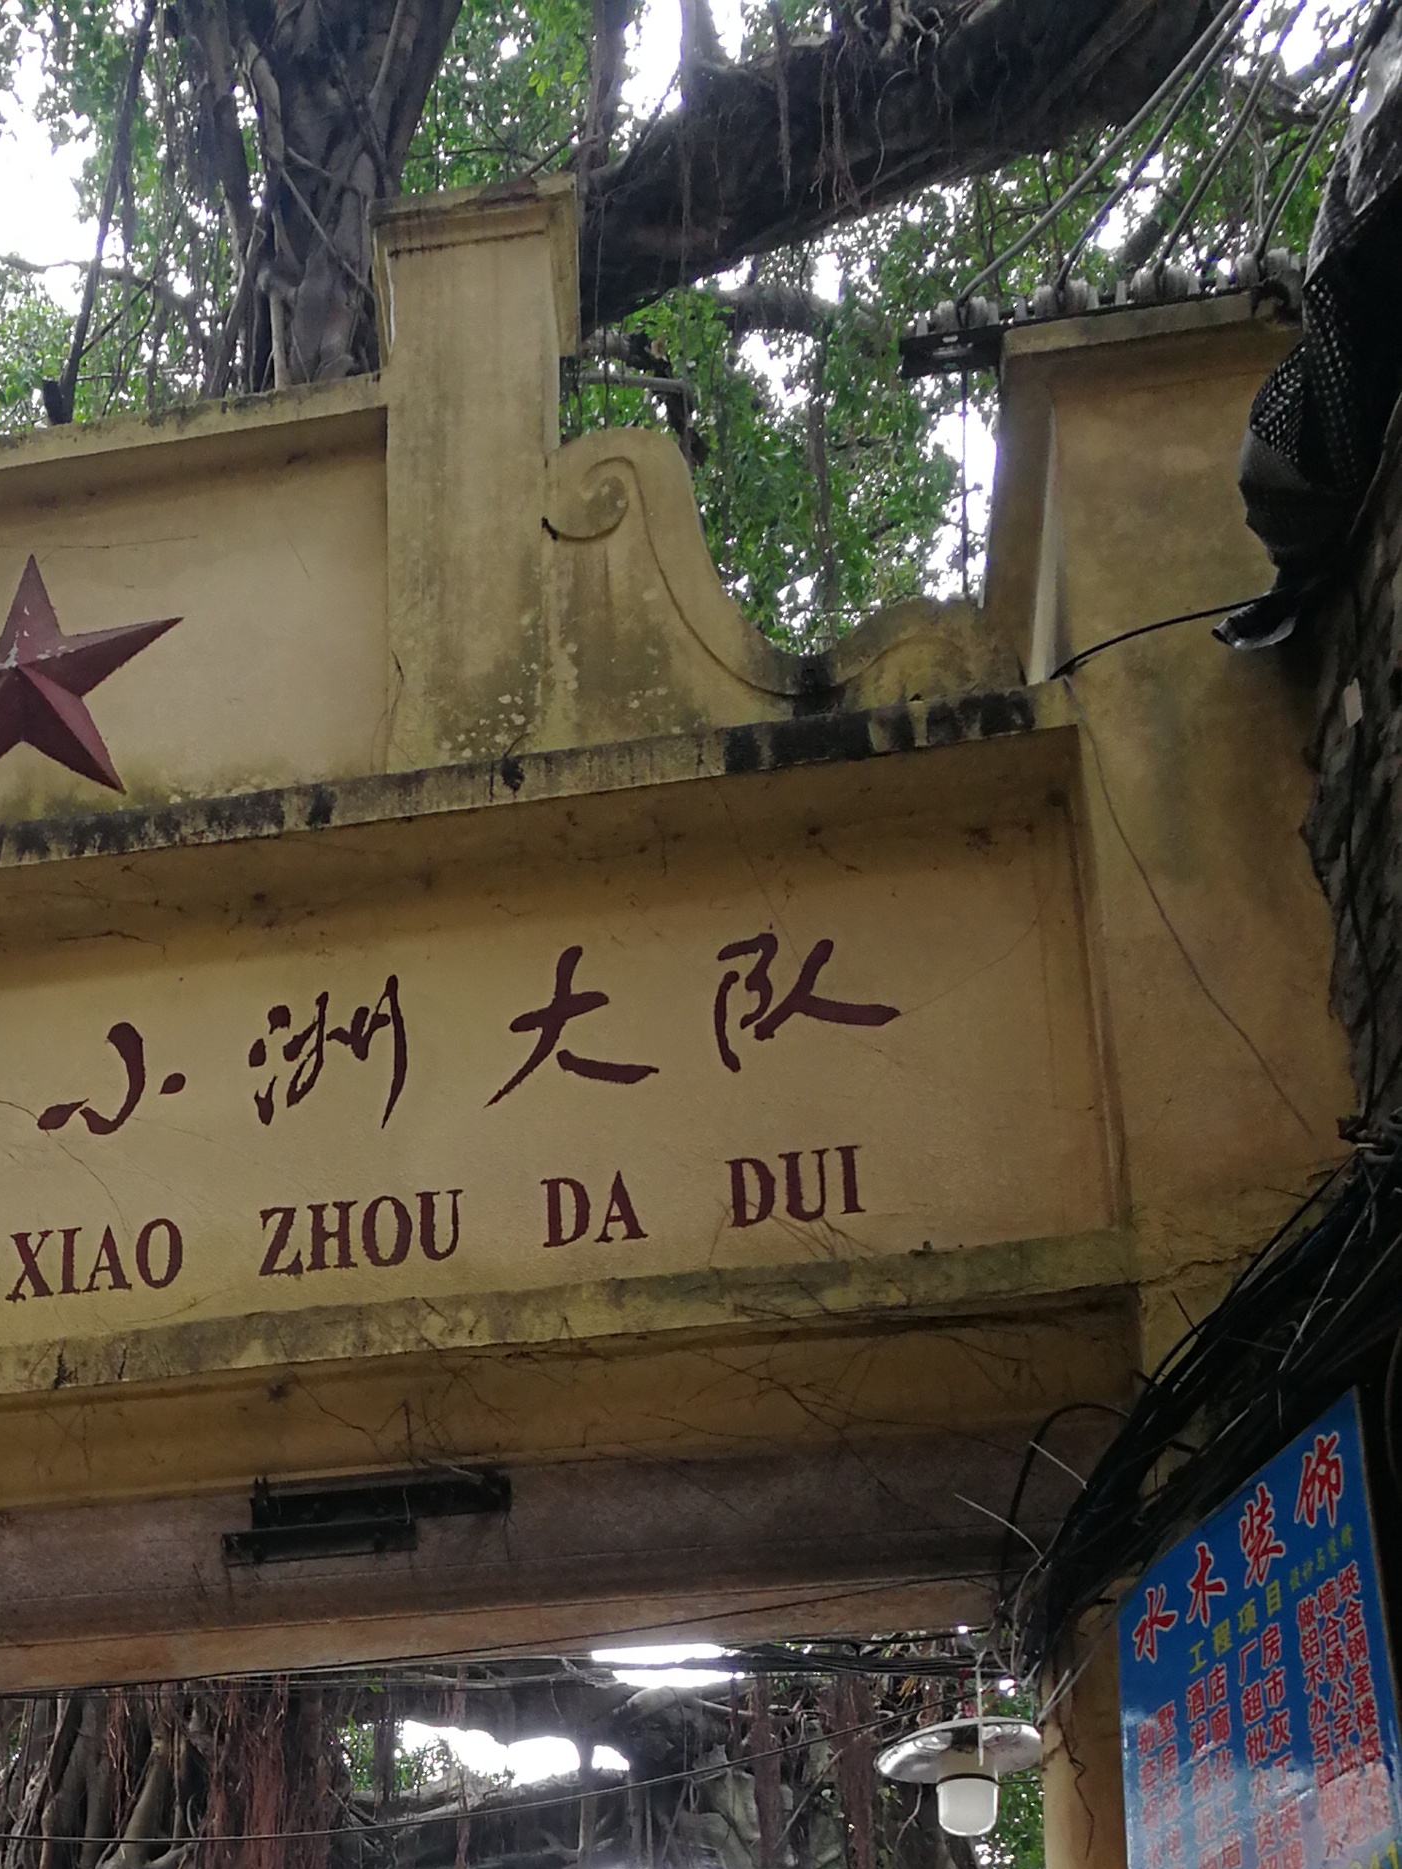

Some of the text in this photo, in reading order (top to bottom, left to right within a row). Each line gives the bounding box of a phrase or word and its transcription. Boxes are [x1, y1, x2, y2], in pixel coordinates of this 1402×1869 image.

[4, 1216, 185, 1304] XIAO
[258, 1188, 464, 1277] ZHOU
[540, 1168, 648, 1249] DA
[724, 1143, 868, 1229] DUI
[1132, 1432, 1342, 1660] 水木装饰
[1188, 1578, 1282, 1675] 工程项目
[1296, 1563, 1360, 1630] 做墙纸
[1299, 1599, 1362, 1662] 铝合金
[1304, 1628, 1367, 1691] 不锈钢
[1137, 1623, 1281, 1755] 别墅 酒店 厂房
[1308, 1662, 1372, 1728] 办公室
[1140, 1668, 1285, 1791] 套房 发廊 超市
[1244, 1709, 1290, 1765] 批灰
[1310, 1696, 1378, 1756] 写字楼
[1255, 1799, 1301, 1853] 货架
